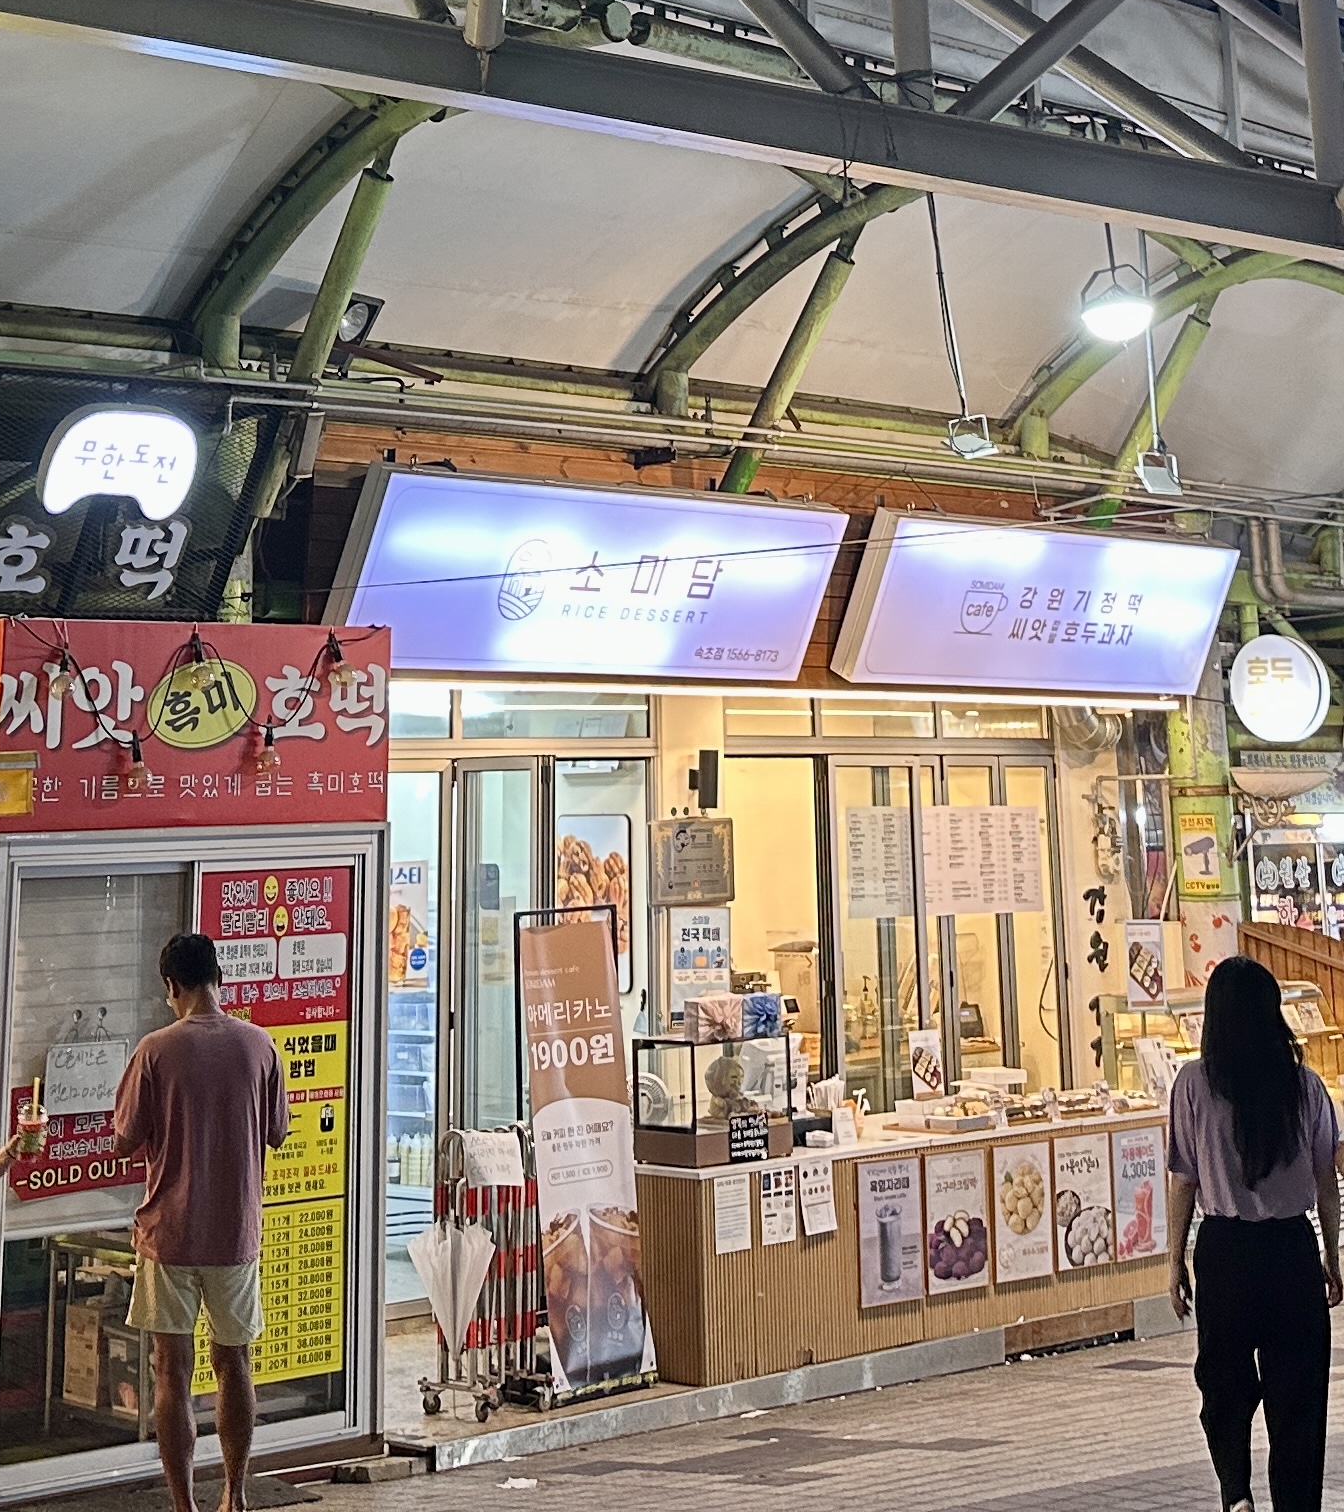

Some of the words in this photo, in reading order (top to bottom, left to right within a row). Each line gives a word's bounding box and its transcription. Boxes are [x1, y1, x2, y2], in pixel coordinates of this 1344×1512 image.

[73, 437, 178, 486] 무한도전
[561, 604, 608, 620] RICE
[620, 607, 709, 625] DESSERT
[965, 600, 994, 619] cafe
[1007, 617, 1047, 642] 씨앗
[1061, 620, 1134, 647] 호두과자
[693, 645, 724, 661] 속초점
[726, 648, 780, 664] 1566-8173
[1246, 656, 1295, 686] 호두
[162, 671, 242, 732] 흑미
[260, 664, 390, 748] 호떡
[80, 775, 167, 801] 기름으로
[180, 773, 243, 799] 맛있게
[307, 770, 385, 797] 흑미호떡
[1278, 855, 1311, 889] 원산
[222, 880, 259, 907] 맛있게
[285, 877, 322, 905] 좋아요
[1185, 881, 1206, 890] CCTV
[527, 997, 613, 1029] 아메리카노
[283, 1033, 337, 1056] 식었을때
[530, 1032, 616, 1072] 1900원
[289, 1058, 316, 1079] 방법
[73, 1113, 106, 1135] 모두
[1121, 1158, 1156, 1182] 4,300원
[271, 1215, 291, 1227] 11개
[271, 1231, 291, 1243] 12개
[271, 1246, 291, 1258] 13개
[271, 1262, 291, 1274] 14개
[270, 1277, 290, 1290] 15개
[270, 1293, 290, 1306] 16개
[270, 1309, 290, 1322] 17개
[270, 1325, 290, 1338] 18개
[269, 1341, 289, 1354] 19개
[269, 1357, 289, 1371] 20개
